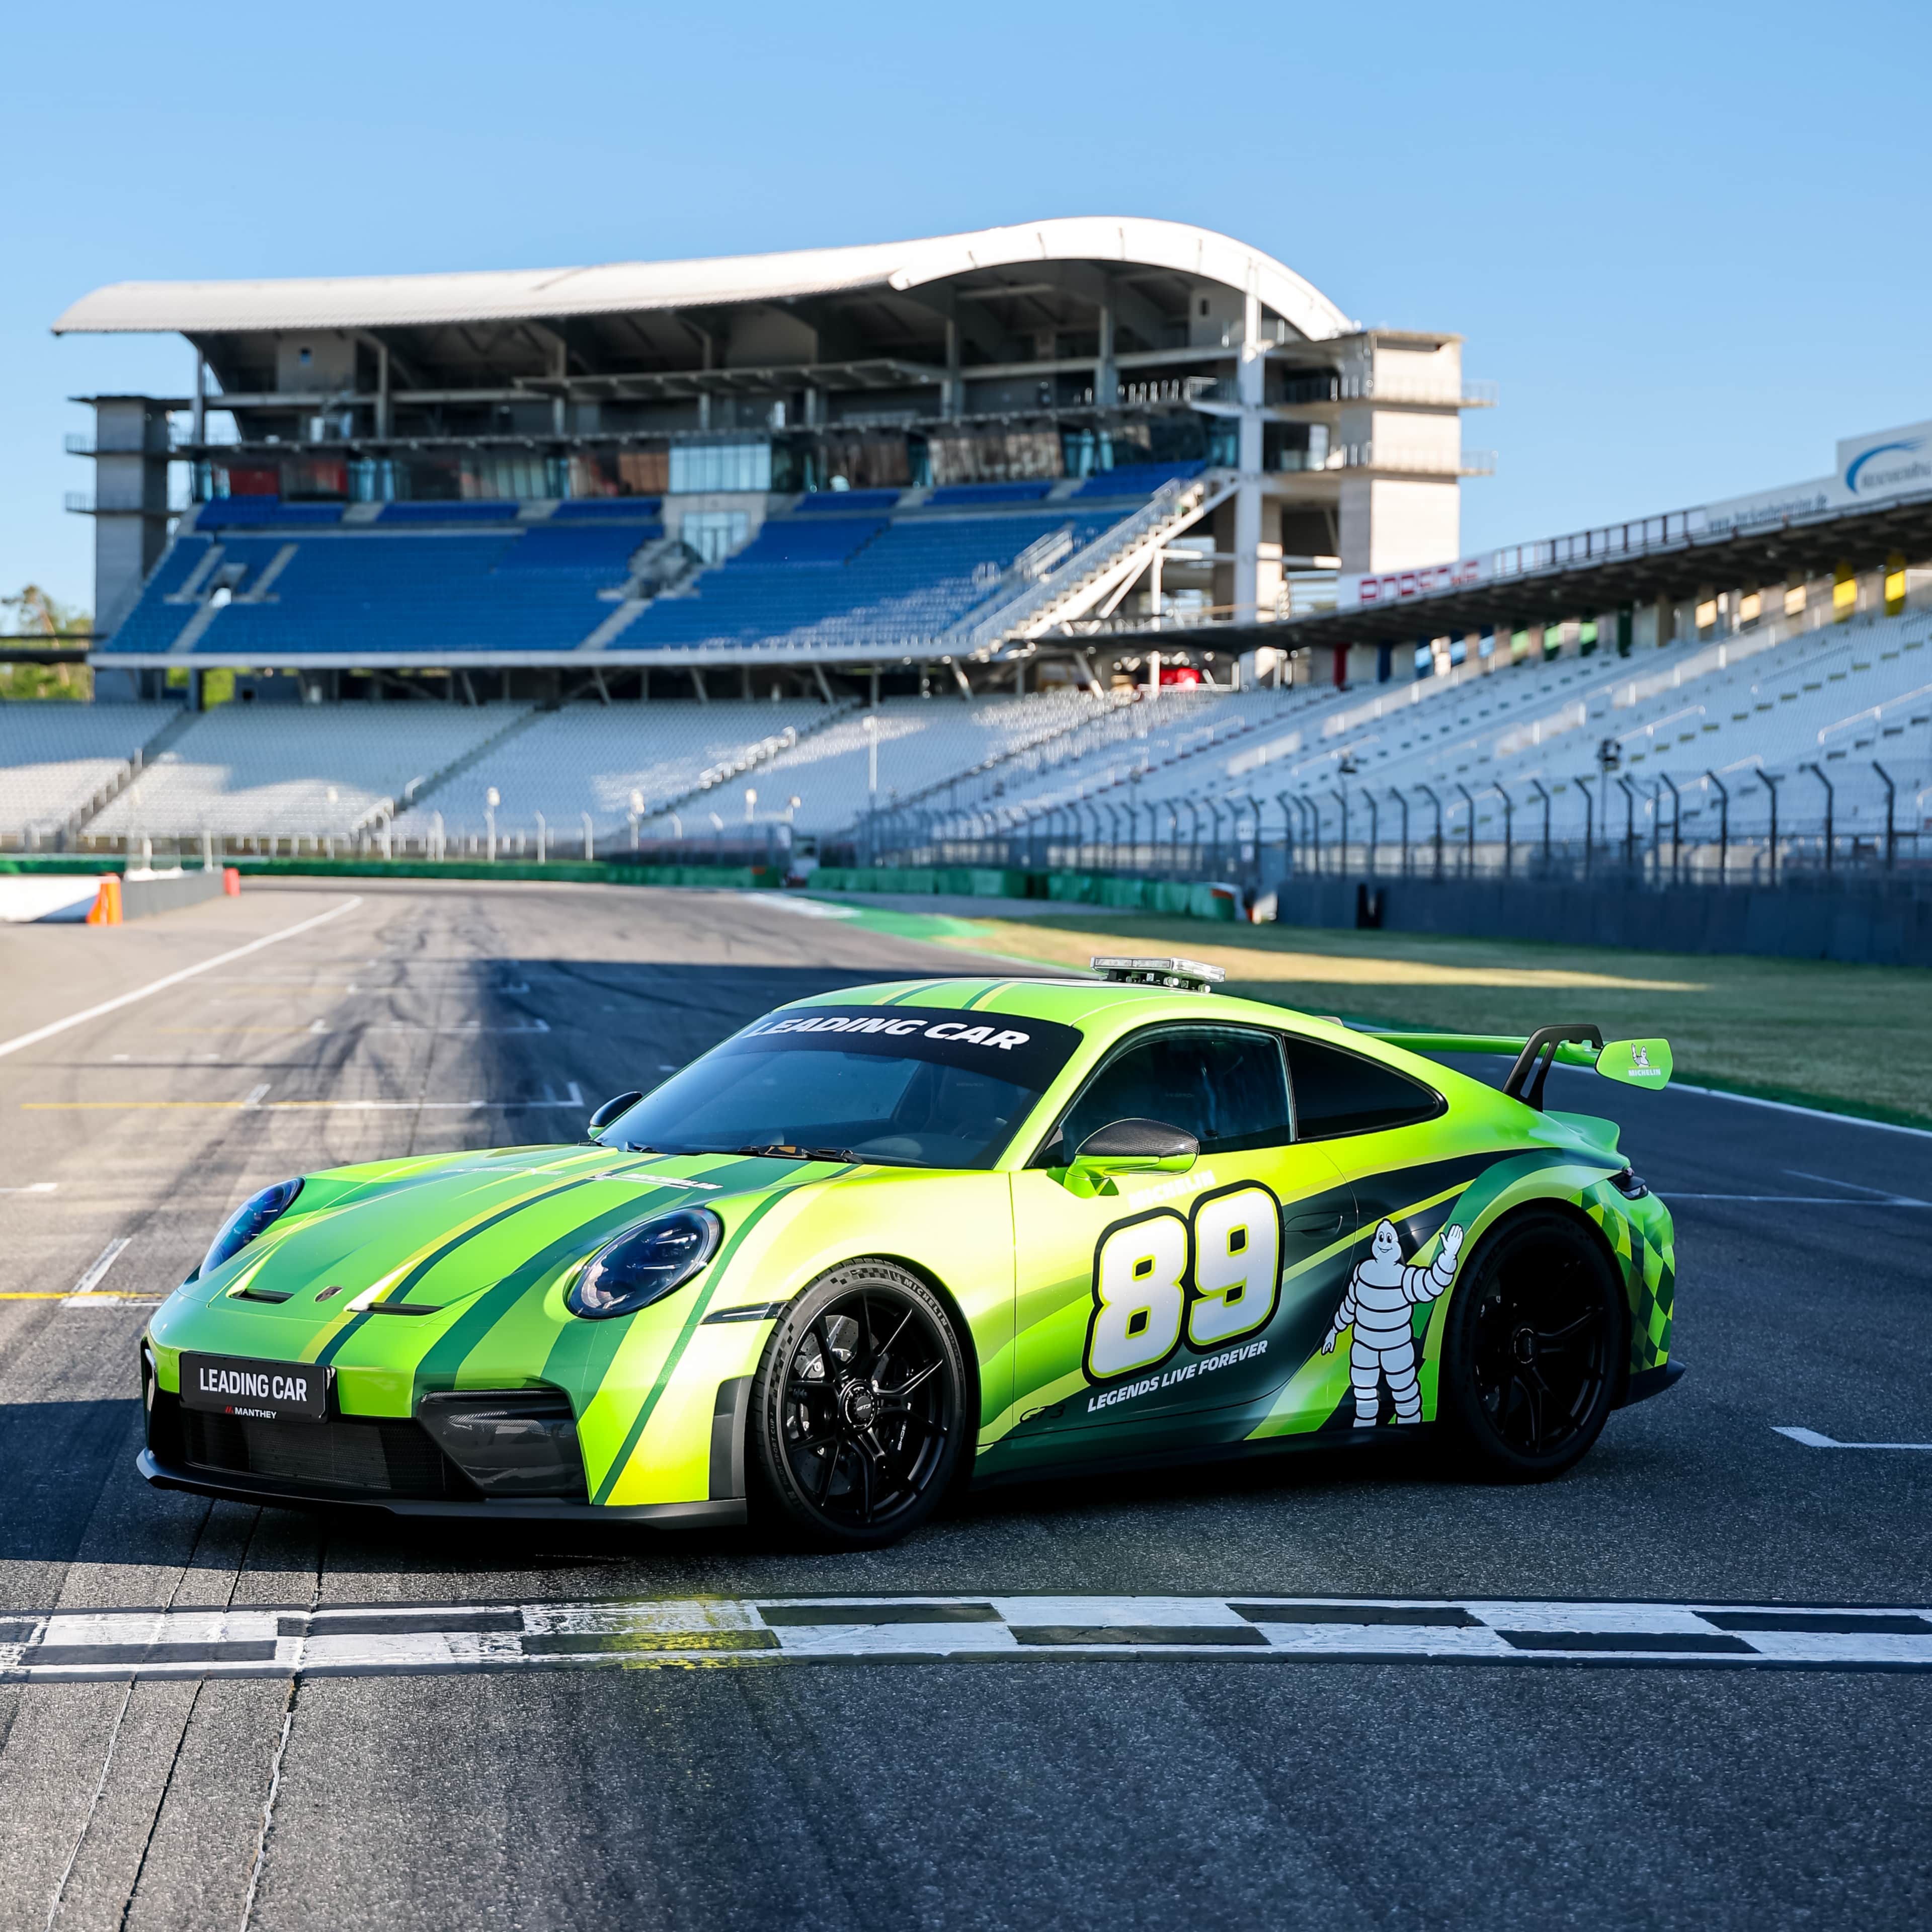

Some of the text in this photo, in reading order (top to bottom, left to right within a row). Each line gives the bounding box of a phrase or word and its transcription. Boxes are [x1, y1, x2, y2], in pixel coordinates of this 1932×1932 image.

[742, 1017, 1030, 1050] LEADING CAR
[1628, 1068, 1661, 1077] MICHELIN
[1127, 1169, 1216, 1210] MICHELIN
[1085, 1182, 1282, 1383] 89
[904, 1278, 947, 1326] MICHELIN
[200, 1368, 307, 1402] LEADING CAR
[1087, 1340, 1268, 1412] LEGENDS LIVE FOREVER
[234, 1407, 277, 1419] MANTHEY
[857, 1403, 871, 1411] GT3
[1019, 1404, 1066, 1423] GT3
